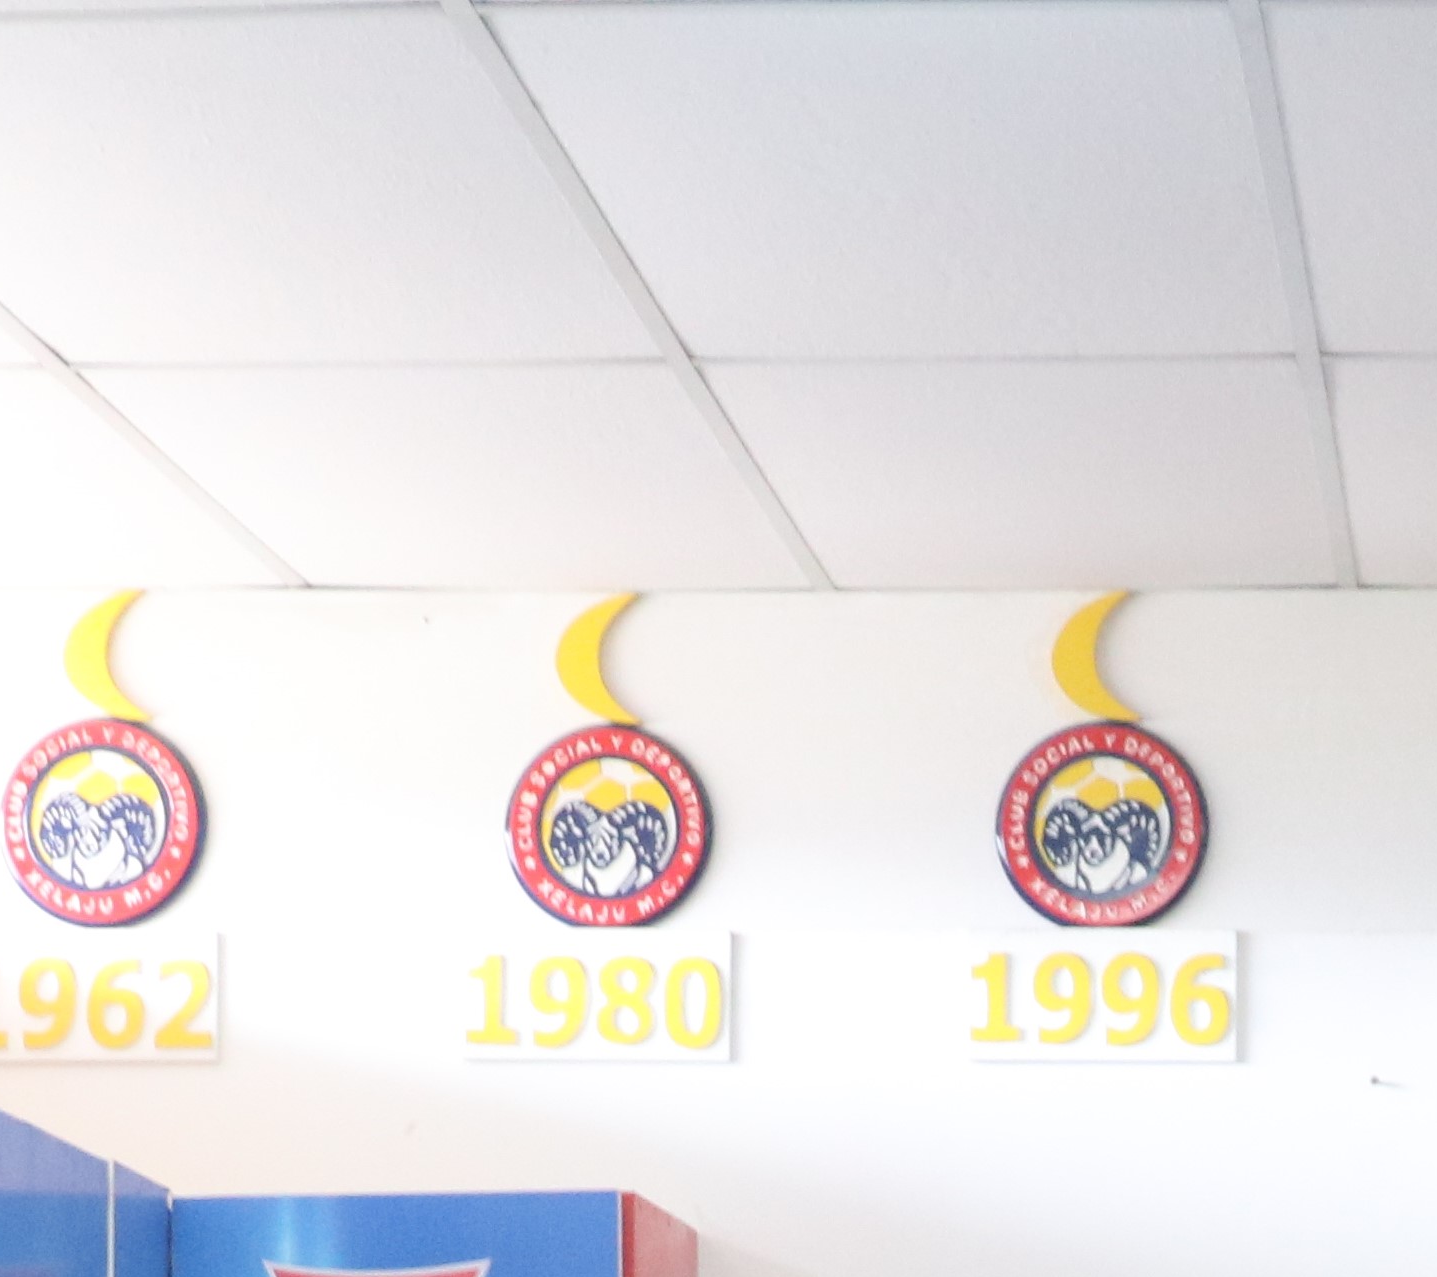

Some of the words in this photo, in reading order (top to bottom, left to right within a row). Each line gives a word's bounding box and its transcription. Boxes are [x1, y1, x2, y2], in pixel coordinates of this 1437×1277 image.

[8, 780, 28, 842] CLUB
[21, 727, 94, 778] SOCIAL
[518, 791, 537, 850] CLUB
[530, 736, 602, 788] SOCIAL
[465, 956, 723, 1050] 1980
[970, 952, 1232, 1047] 1996
